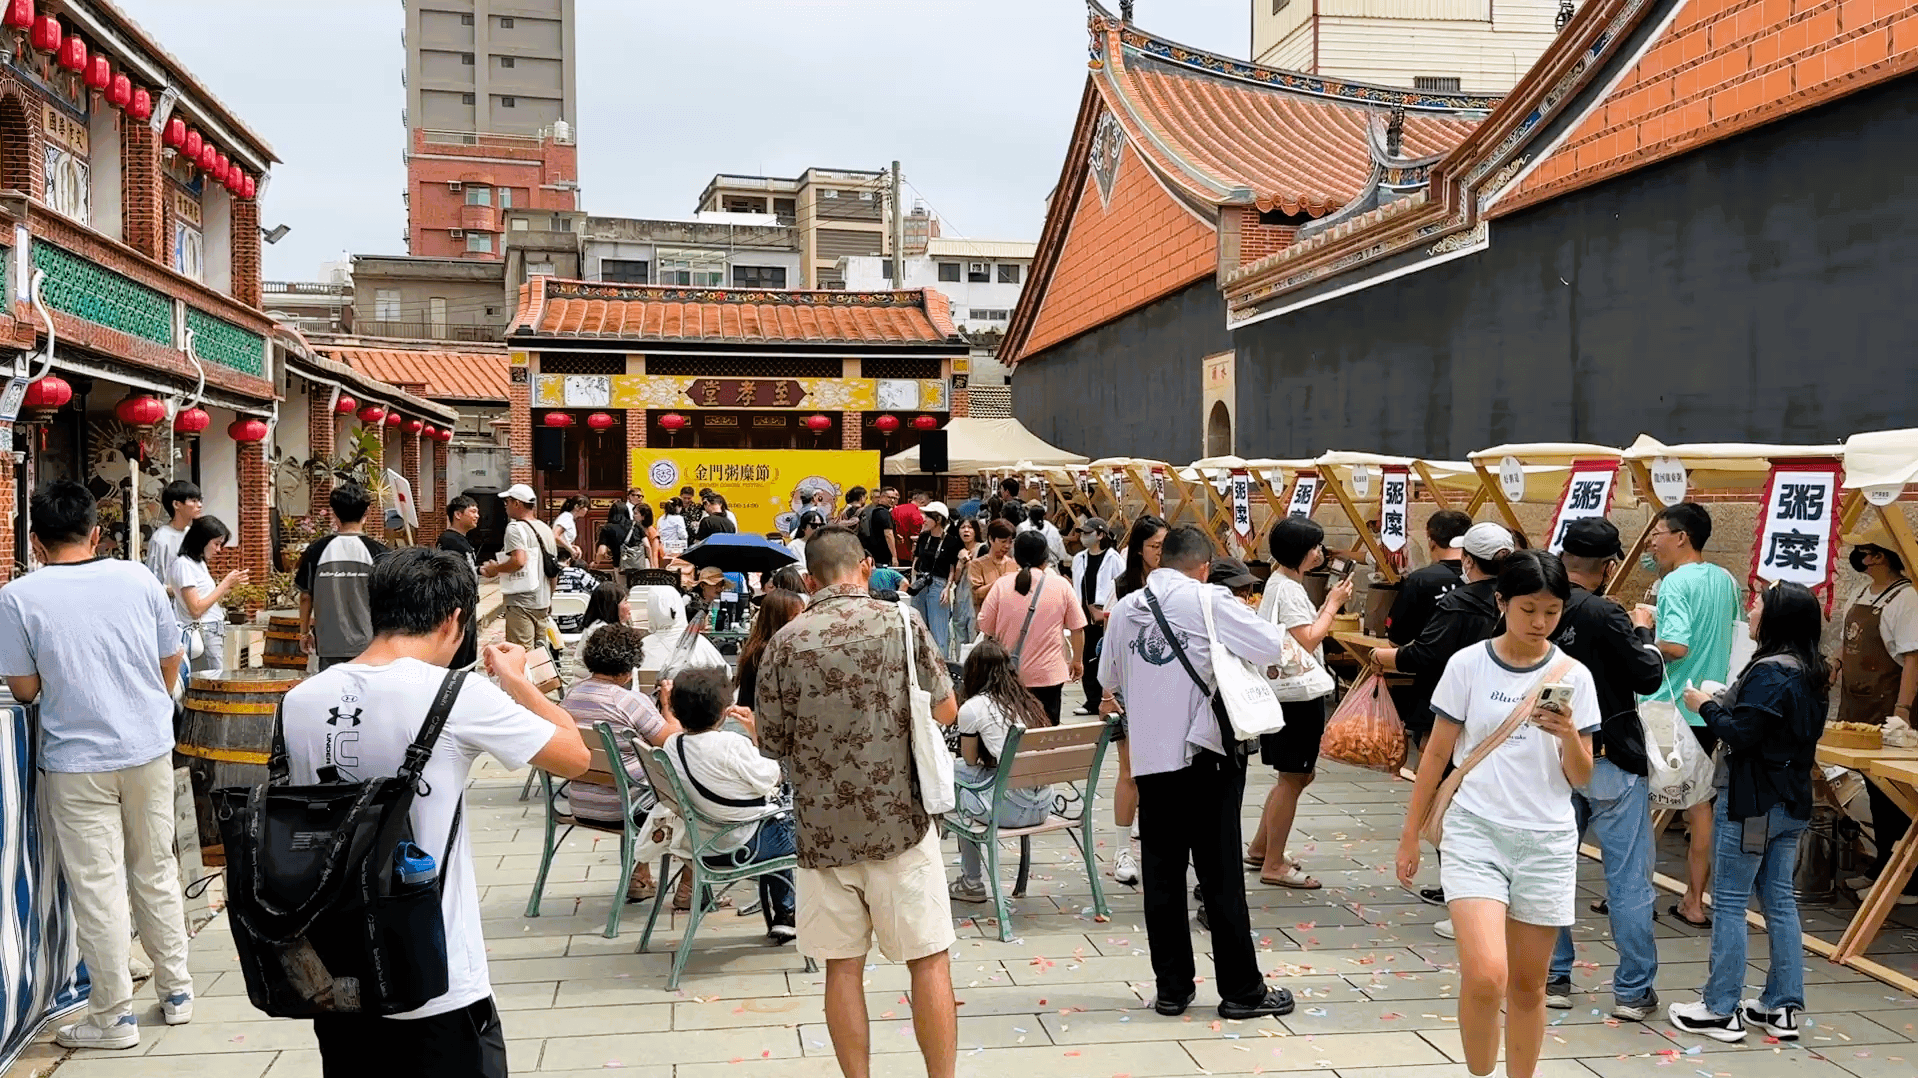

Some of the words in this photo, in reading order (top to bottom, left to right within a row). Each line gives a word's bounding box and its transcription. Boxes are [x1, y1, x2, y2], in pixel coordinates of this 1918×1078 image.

[1235, 481, 1248, 525] 粥糜
[1290, 484, 1313, 517] 粥
[1383, 481, 1404, 537] 粥糜
[1764, 484, 1826, 572] 粥糜
